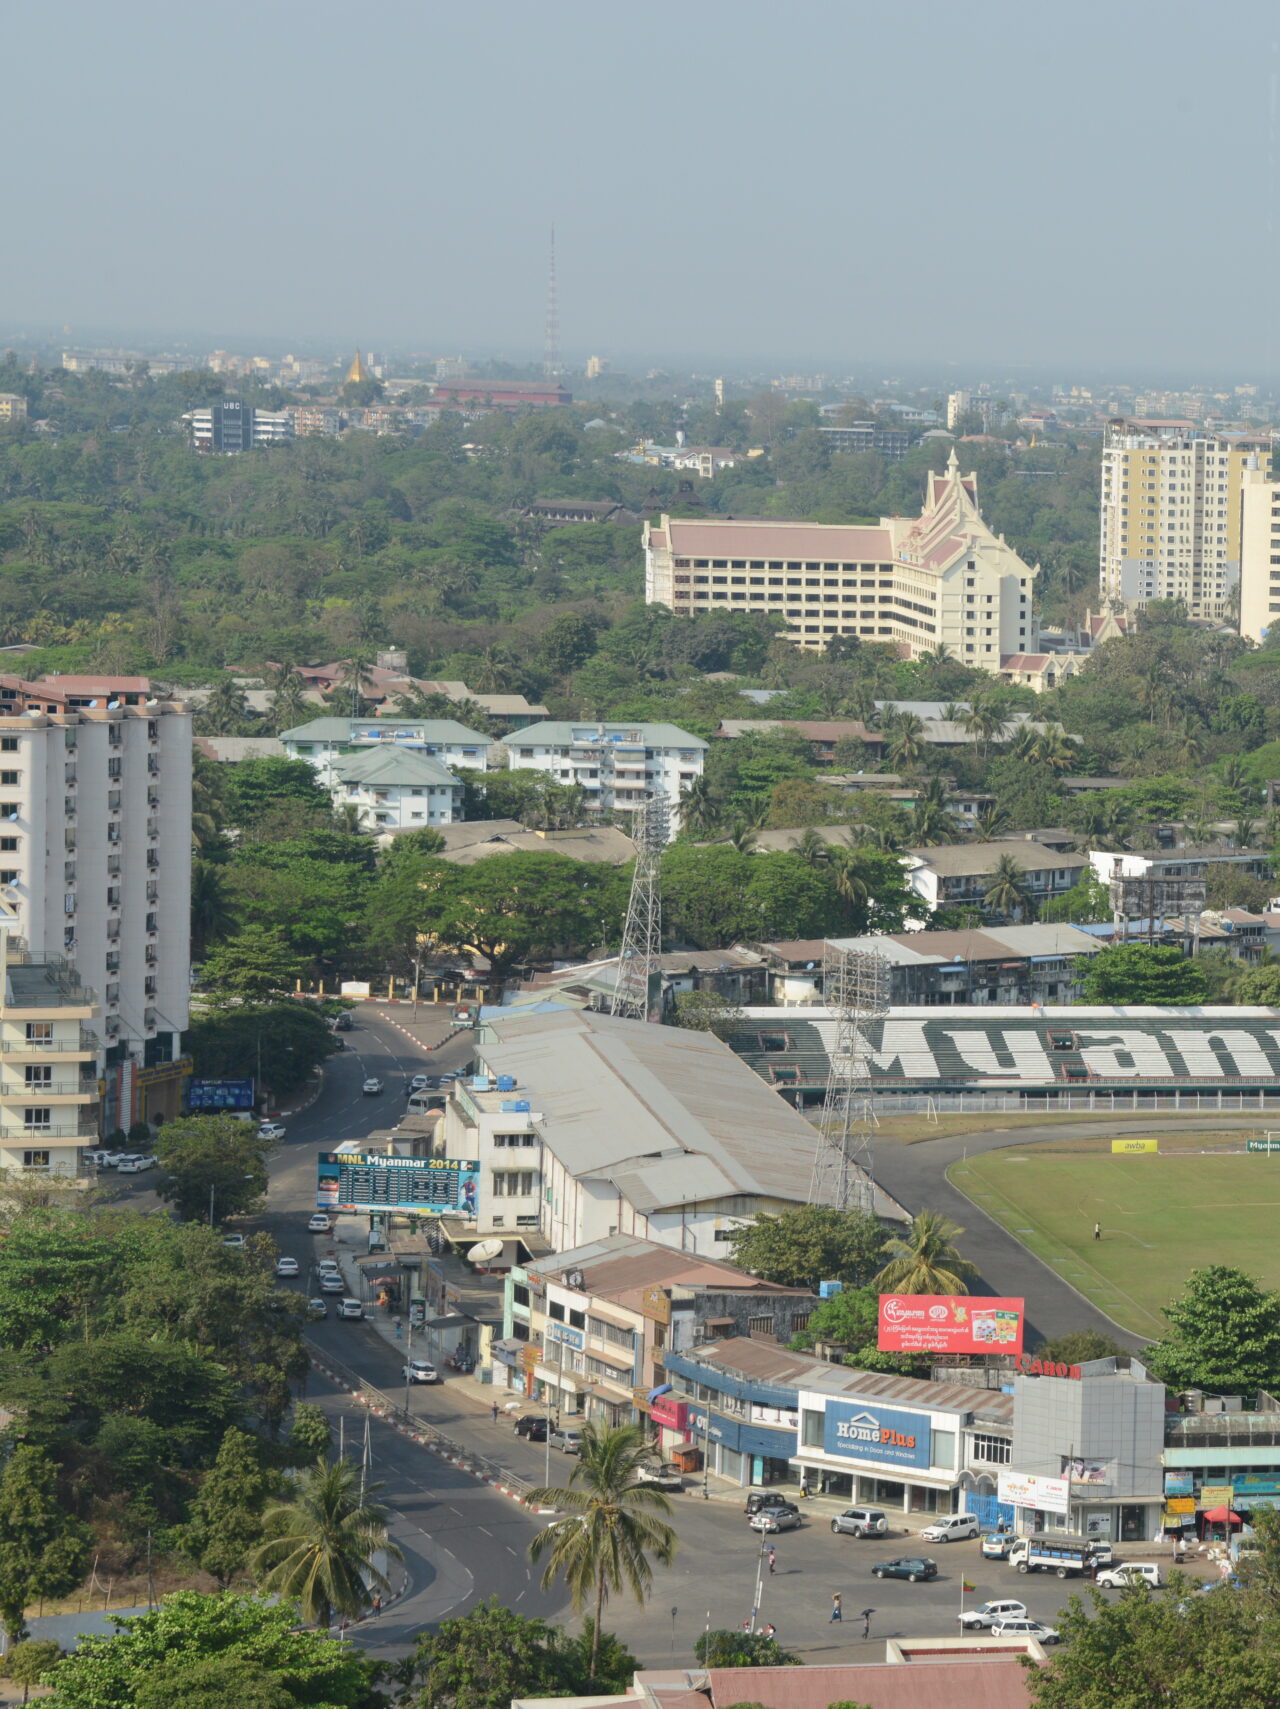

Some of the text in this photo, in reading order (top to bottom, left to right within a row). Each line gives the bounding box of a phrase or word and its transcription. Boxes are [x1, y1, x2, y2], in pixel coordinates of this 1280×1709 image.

[337, 1153, 459, 1170] MNL Myanmar 2014
[1014, 1353, 1081, 1380] Canon
